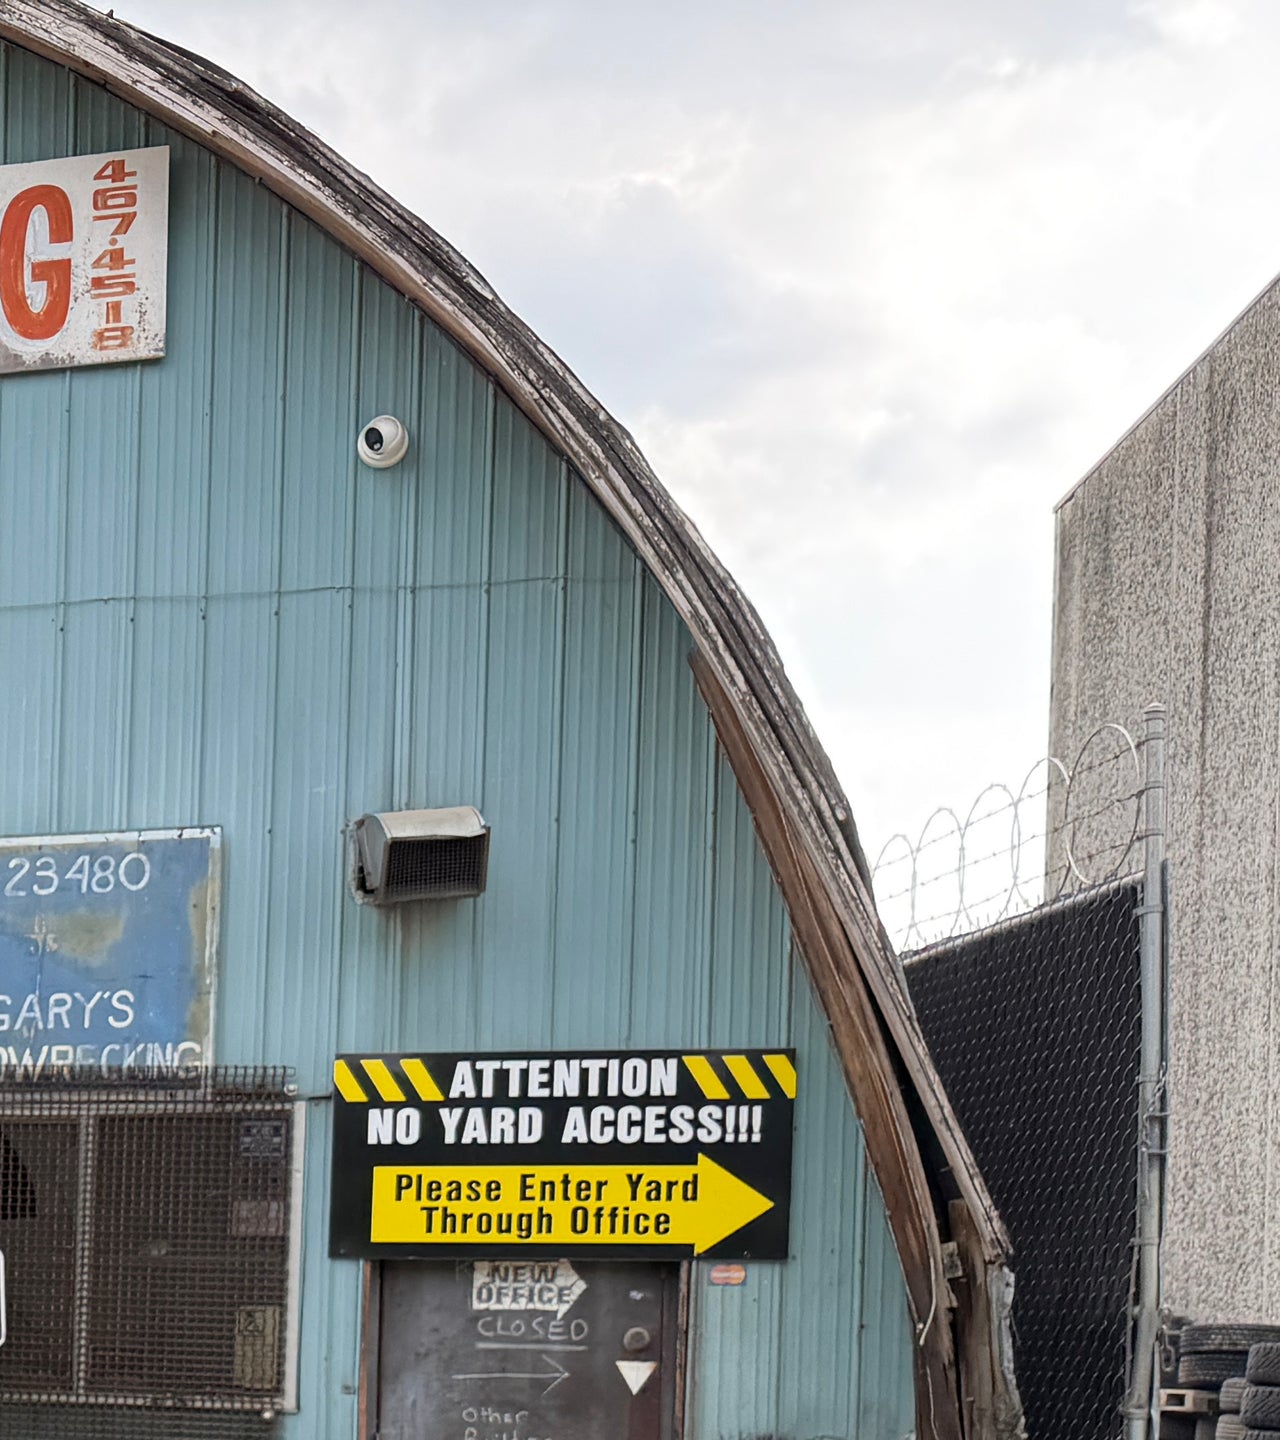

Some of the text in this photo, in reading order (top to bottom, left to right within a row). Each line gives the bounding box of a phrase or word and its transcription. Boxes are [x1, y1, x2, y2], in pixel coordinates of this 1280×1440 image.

[3, 851, 151, 897] 23480
[449, 1057, 679, 1099] ATTENTION
[366, 1104, 763, 1145] NO YARD ACCESS!!!
[394, 1173, 700, 1203] Please Enter Yard
[419, 1206, 671, 1240] Through Office
[492, 1265, 559, 1283] NEW
[476, 1283, 575, 1306] OFFICE
[476, 1316, 589, 1342] CLOSED
[462, 1407, 528, 1424] Other
